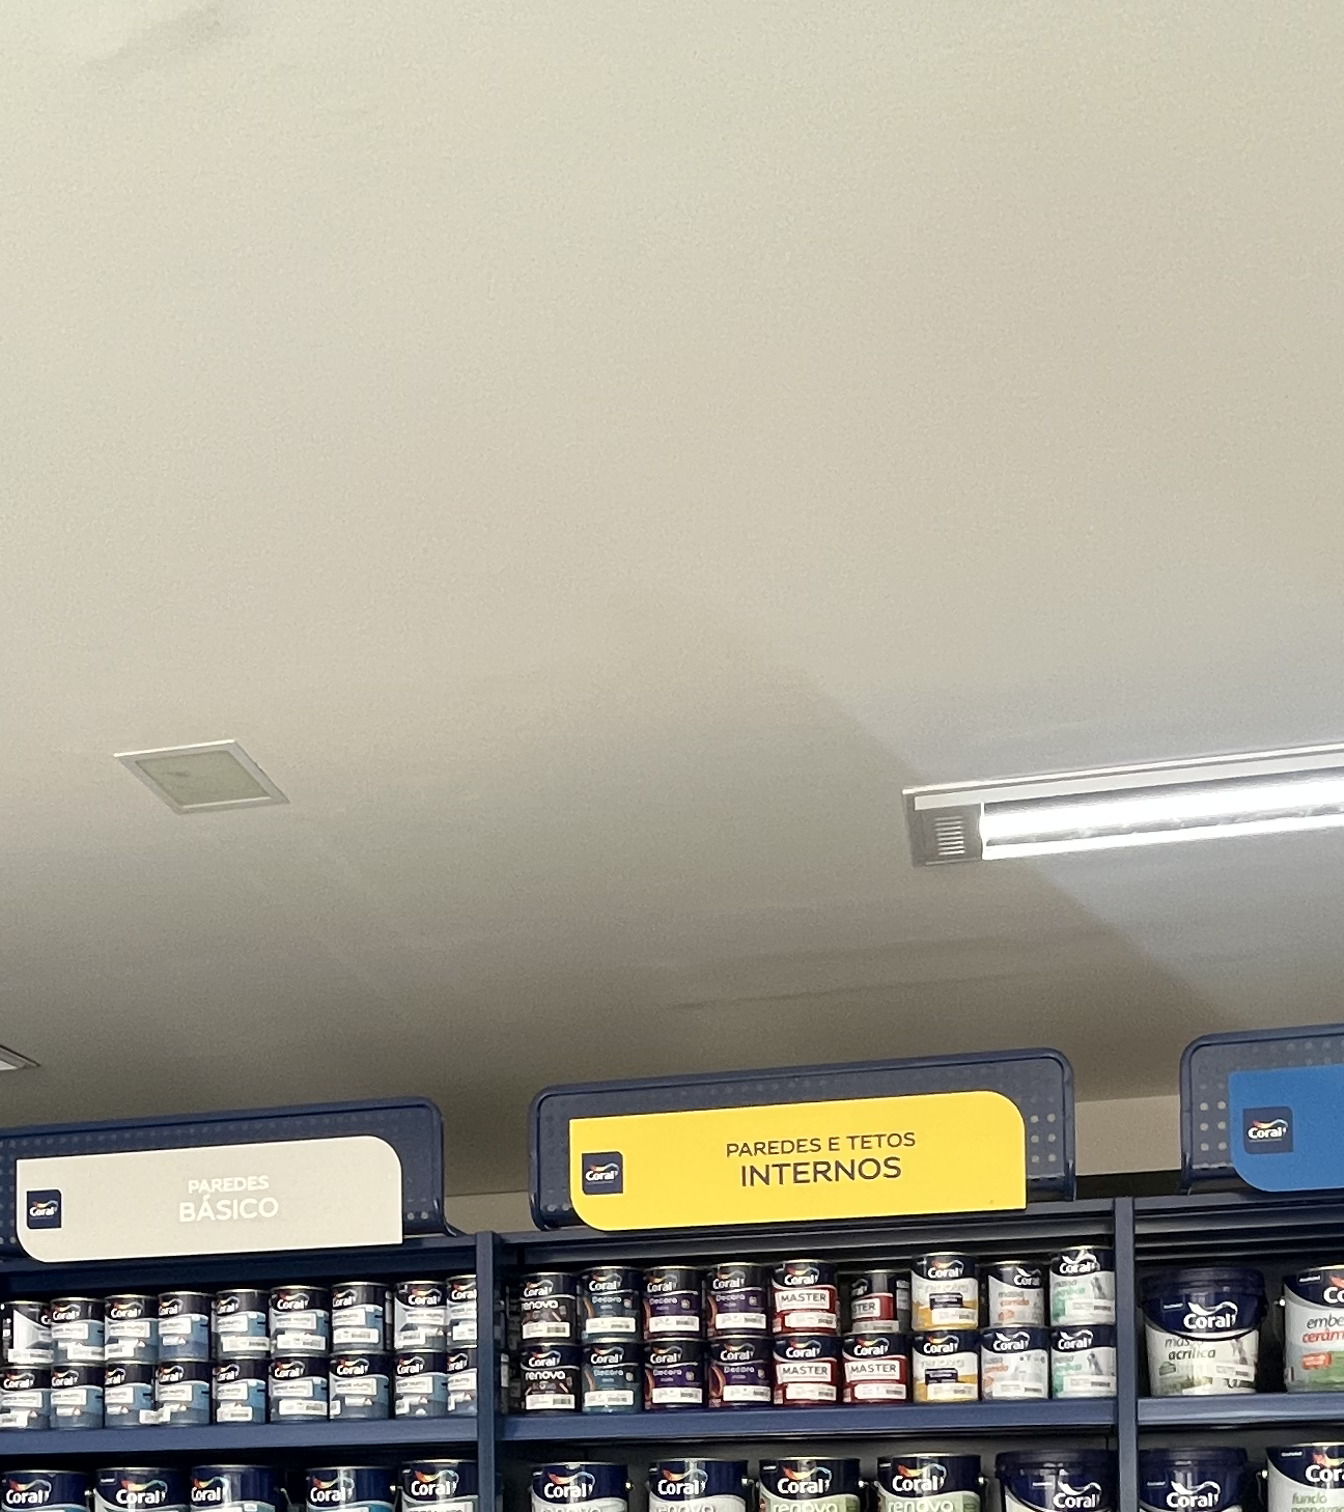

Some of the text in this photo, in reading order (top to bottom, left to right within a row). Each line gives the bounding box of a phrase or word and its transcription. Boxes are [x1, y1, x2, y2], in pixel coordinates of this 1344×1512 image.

[1248, 1124, 1282, 1139] Coral
[727, 1131, 916, 1158] PAREDES E TETOS
[585, 1167, 616, 1181] Coral
[741, 1156, 902, 1187] INTERNOS
[187, 1174, 270, 1196] PAREDES
[29, 1203, 54, 1217] Coral
[179, 1190, 279, 1223] BÁSICO
[1059, 1264, 1090, 1273] Coral
[781, 1293, 828, 1306] MASTER
[1183, 1313, 1231, 1330] Coral
[720, 1350, 748, 1360] Coral
[854, 1345, 885, 1355] Coral
[851, 1364, 896, 1373] MASTER
[411, 1481, 452, 1495] Coral
[544, 1482, 586, 1498] Coral
[778, 1478, 824, 1494] Coral
[892, 1476, 938, 1492] Coral
[116, 1489, 160, 1503] Coral
[1053, 1492, 1096, 1508] Coral
